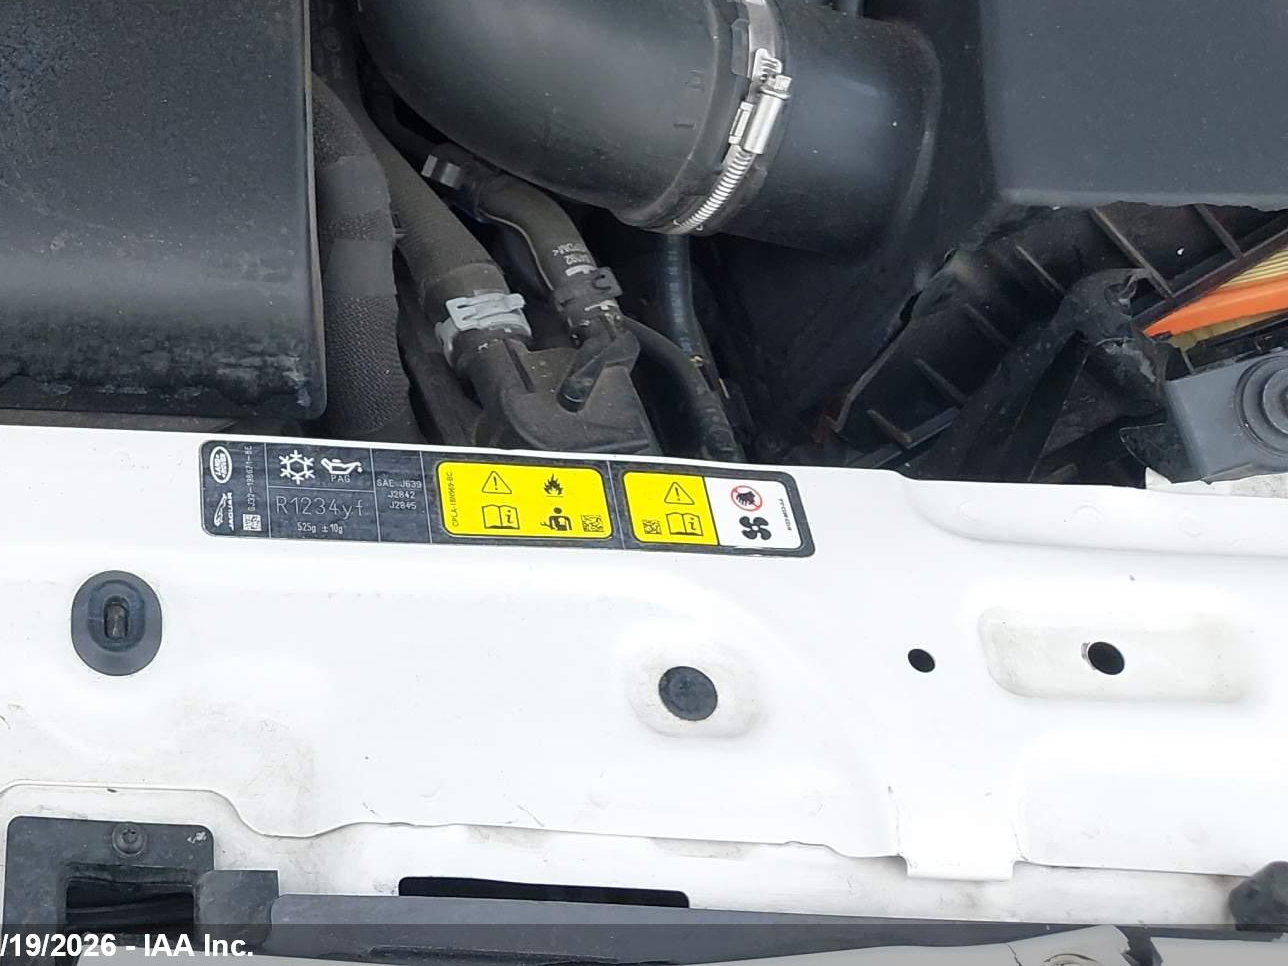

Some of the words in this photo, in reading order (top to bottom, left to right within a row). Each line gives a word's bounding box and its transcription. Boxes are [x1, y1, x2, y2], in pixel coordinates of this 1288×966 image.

[330, 474, 352, 484] PAG
[376, 478, 395, 488] SAE
[400, 479, 423, 489] J639
[387, 489, 416, 500] J2842
[275, 495, 365, 520] R1234yf
[389, 500, 418, 510] J2845
[226, 492, 234, 531] JAGUAR
[296, 521, 316, 534] 525g
